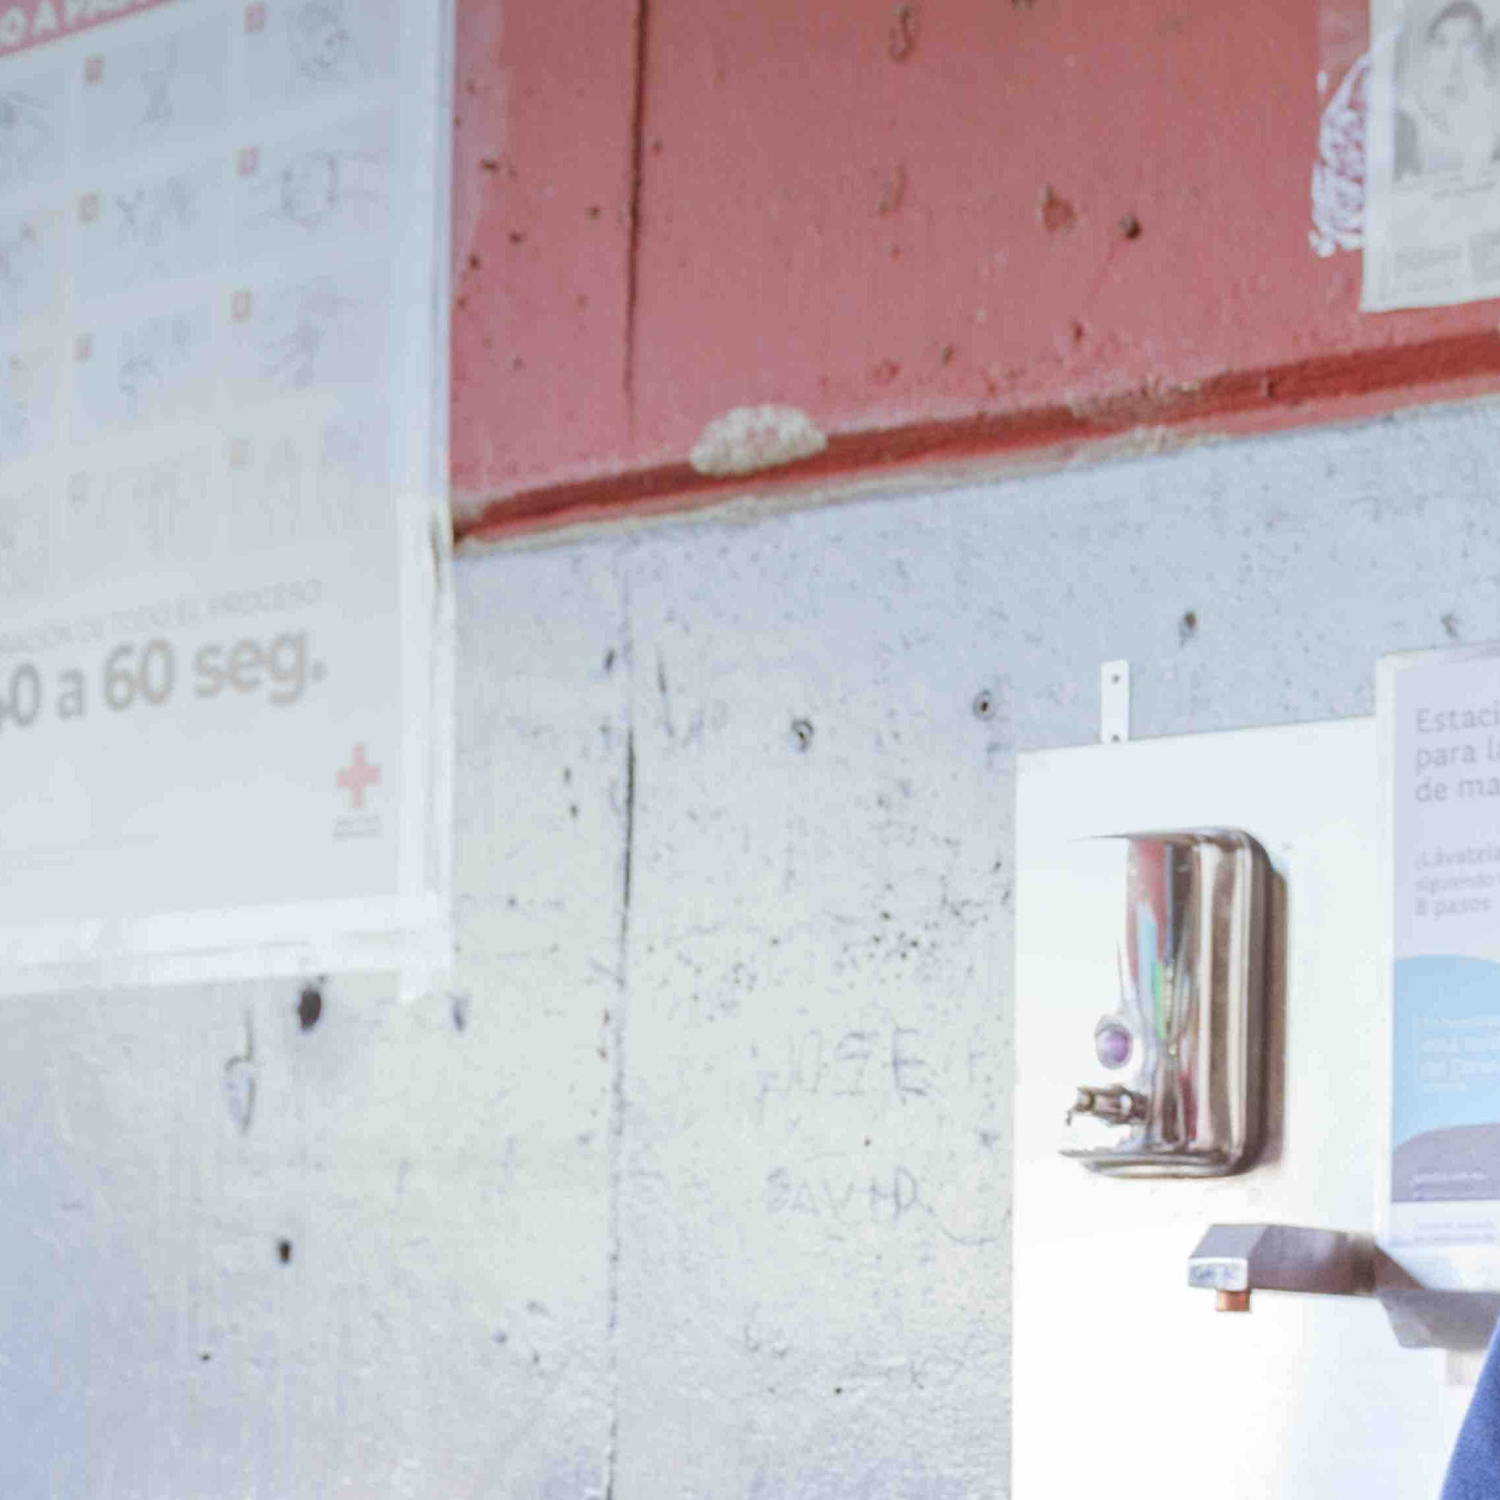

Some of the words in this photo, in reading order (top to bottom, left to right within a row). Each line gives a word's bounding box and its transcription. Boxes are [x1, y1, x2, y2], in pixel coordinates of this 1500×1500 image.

[56, 666, 87, 722] a
[103, 636, 177, 713] 60
[193, 627, 329, 709] seg.
[1415, 743, 1477, 776] para
[1414, 775, 1449, 804] de
[1434, 894, 1492, 921] pasos
